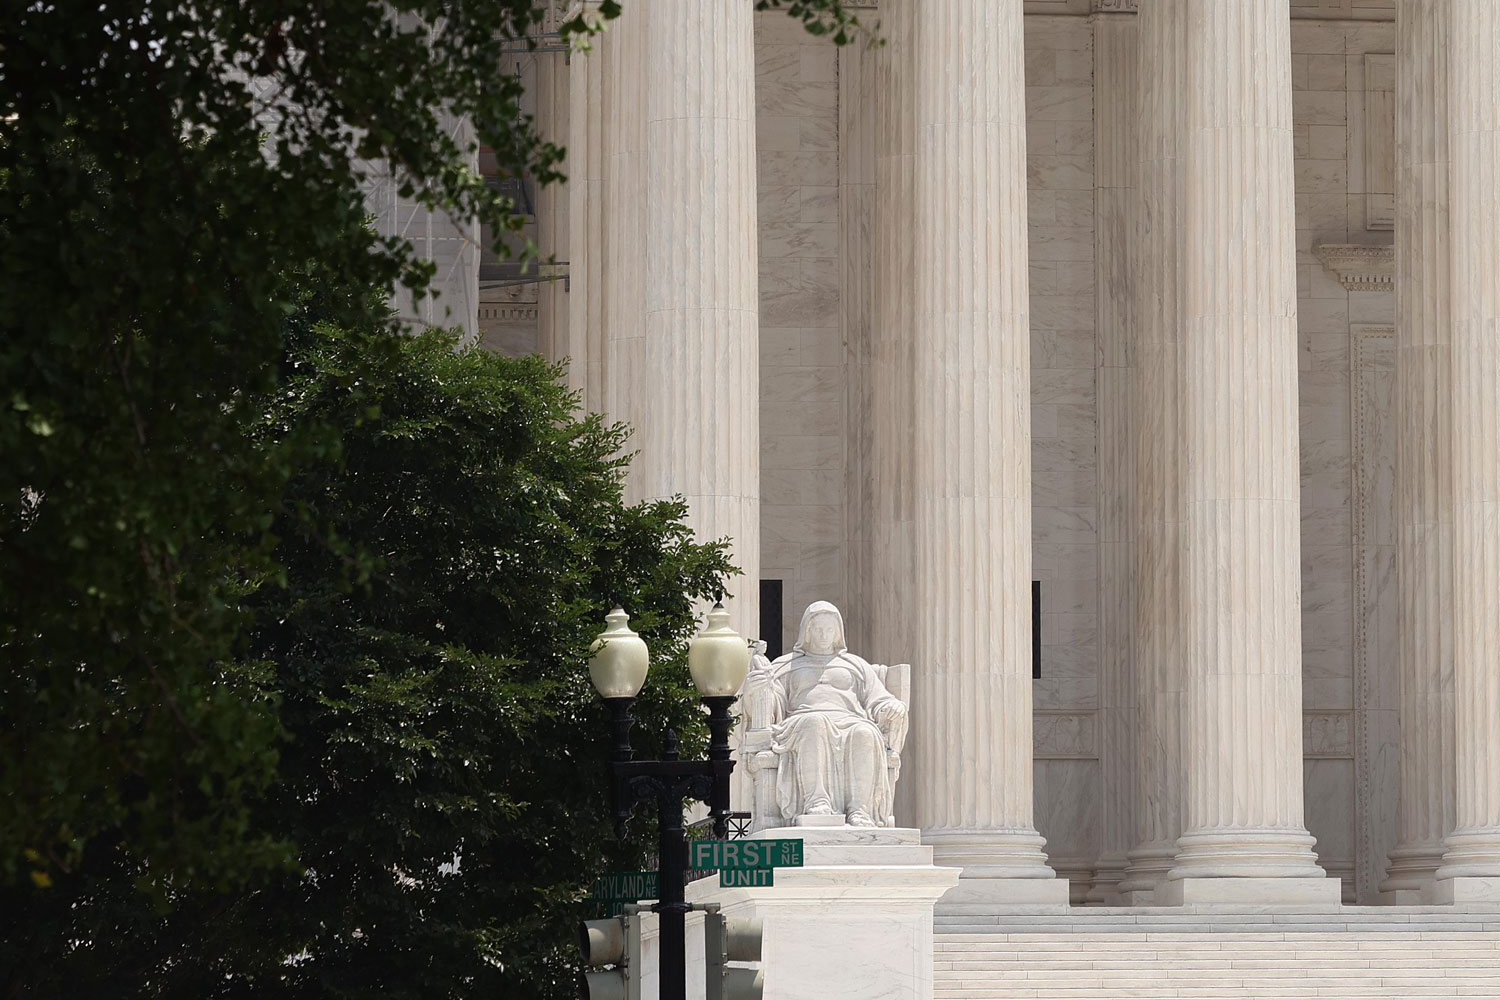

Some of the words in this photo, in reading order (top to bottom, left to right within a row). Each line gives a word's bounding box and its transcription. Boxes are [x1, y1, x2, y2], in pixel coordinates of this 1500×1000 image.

[696, 841, 777, 867] FIRST
[782, 842, 798, 854] ST
[781, 854, 800, 865] NE
[645, 874, 657, 886] AV
[722, 869, 770, 887] UNIT
[593, 874, 645, 899] ARYLAND
[645, 886, 657, 898] NE
